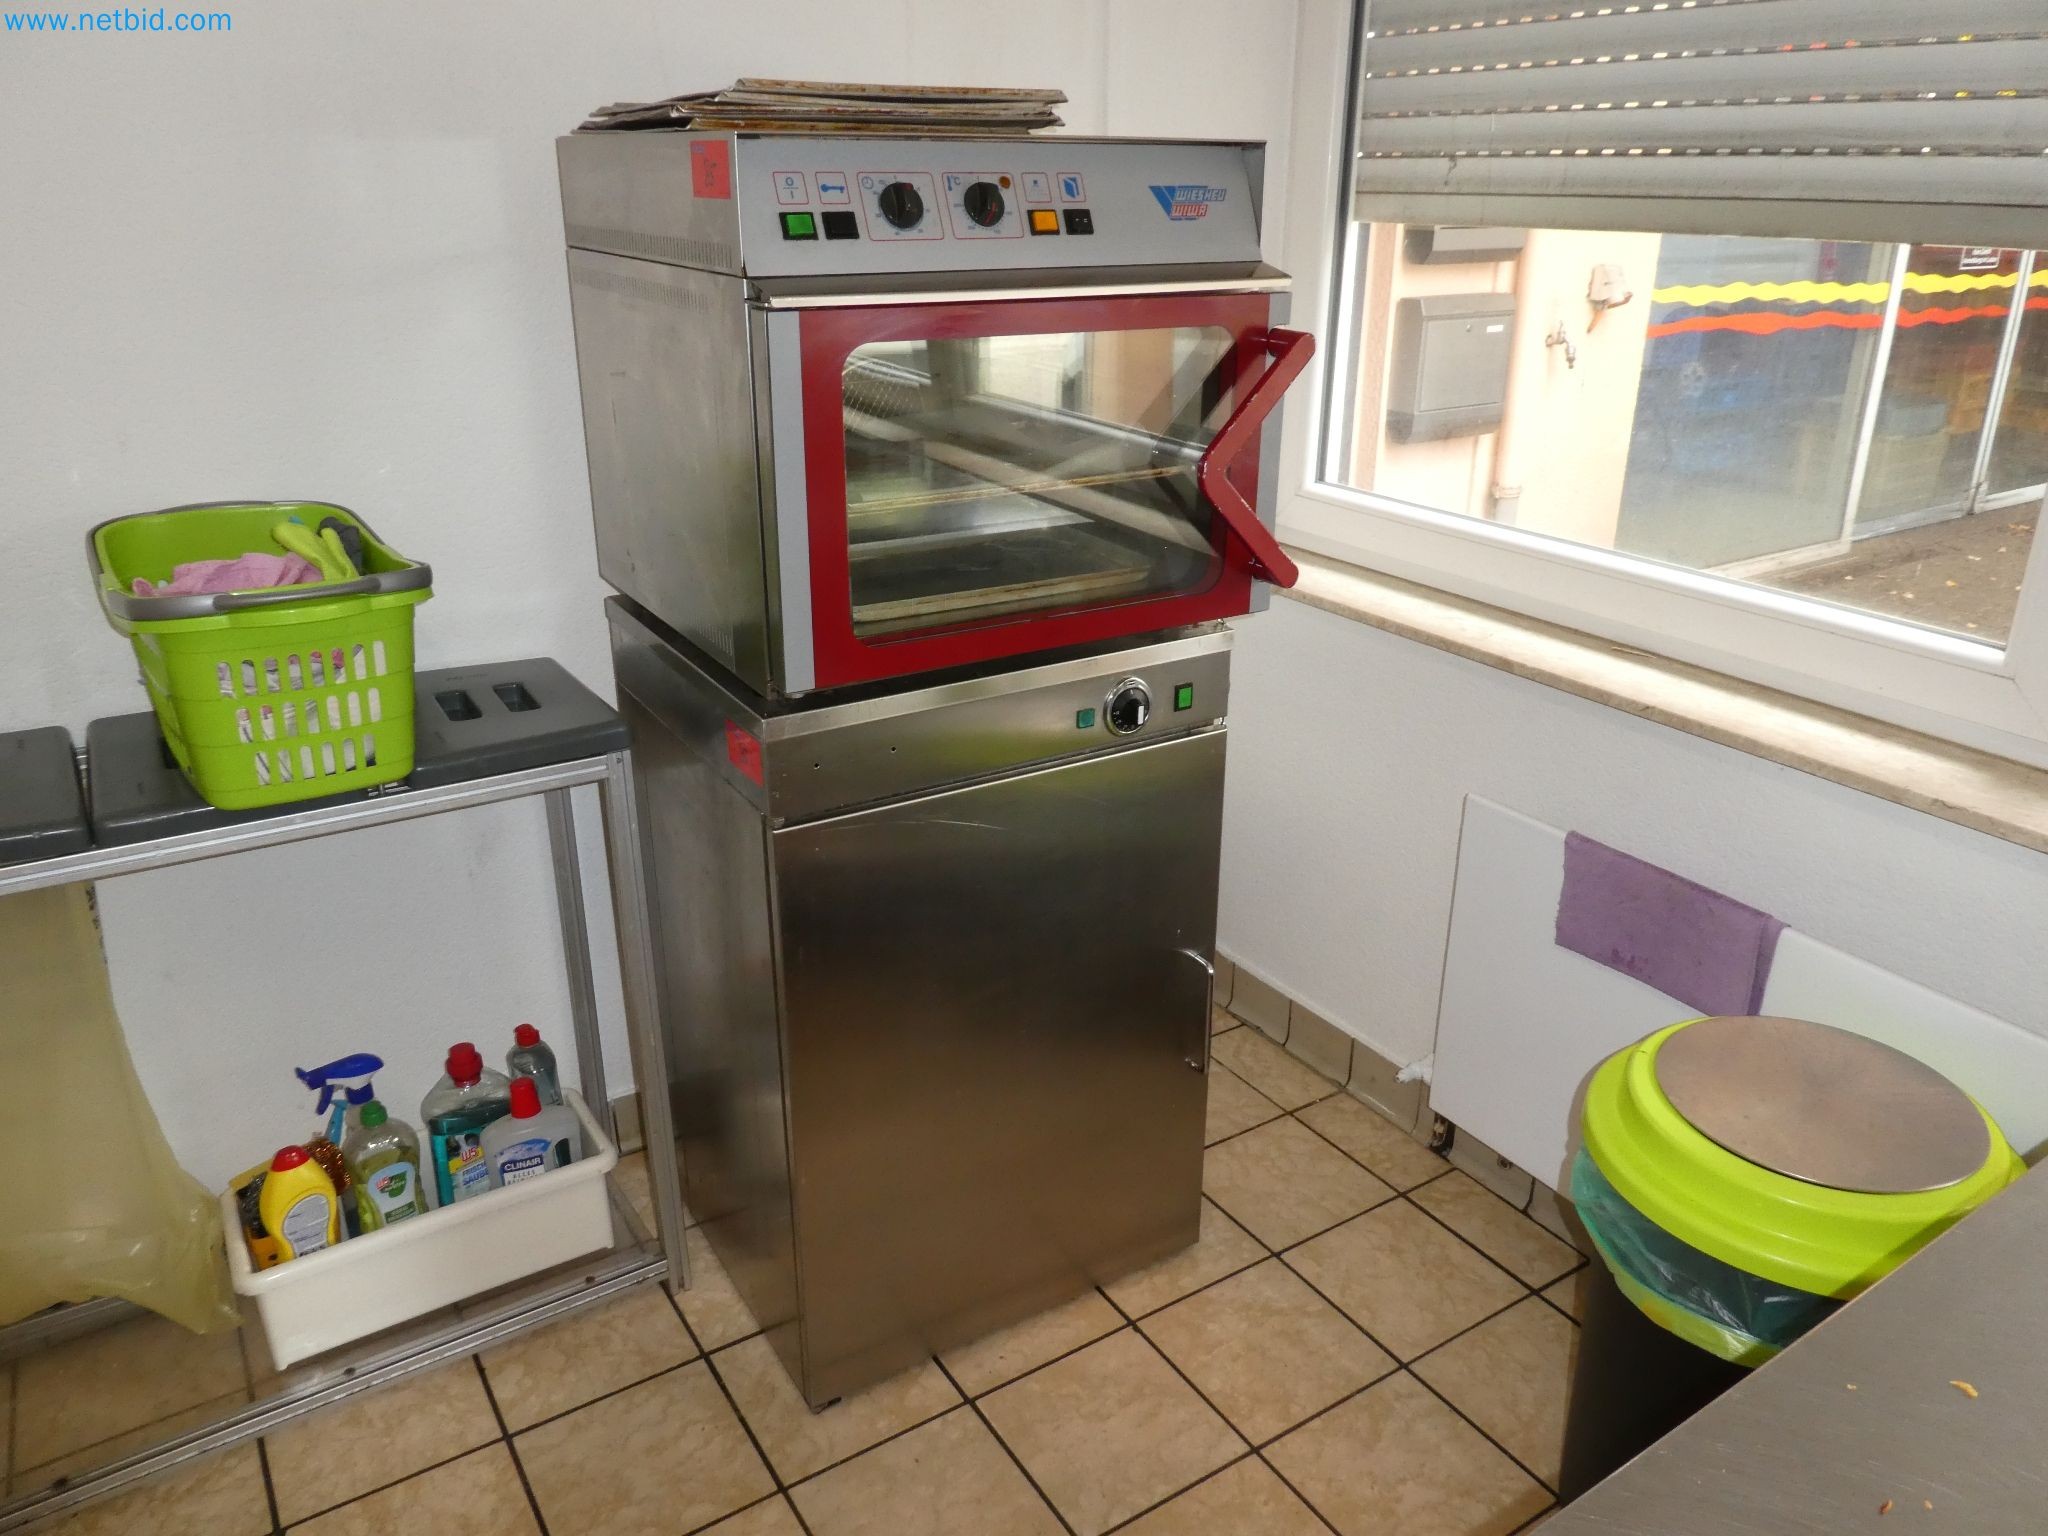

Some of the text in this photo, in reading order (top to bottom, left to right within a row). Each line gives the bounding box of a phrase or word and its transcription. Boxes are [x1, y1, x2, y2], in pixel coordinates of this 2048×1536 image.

[1175, 188, 1227, 202] WIESHEU
[1172, 204, 1208, 217] WIWA
[504, 1157, 541, 1171] CLINAIR
[463, 1168, 489, 1186] SAUBE
